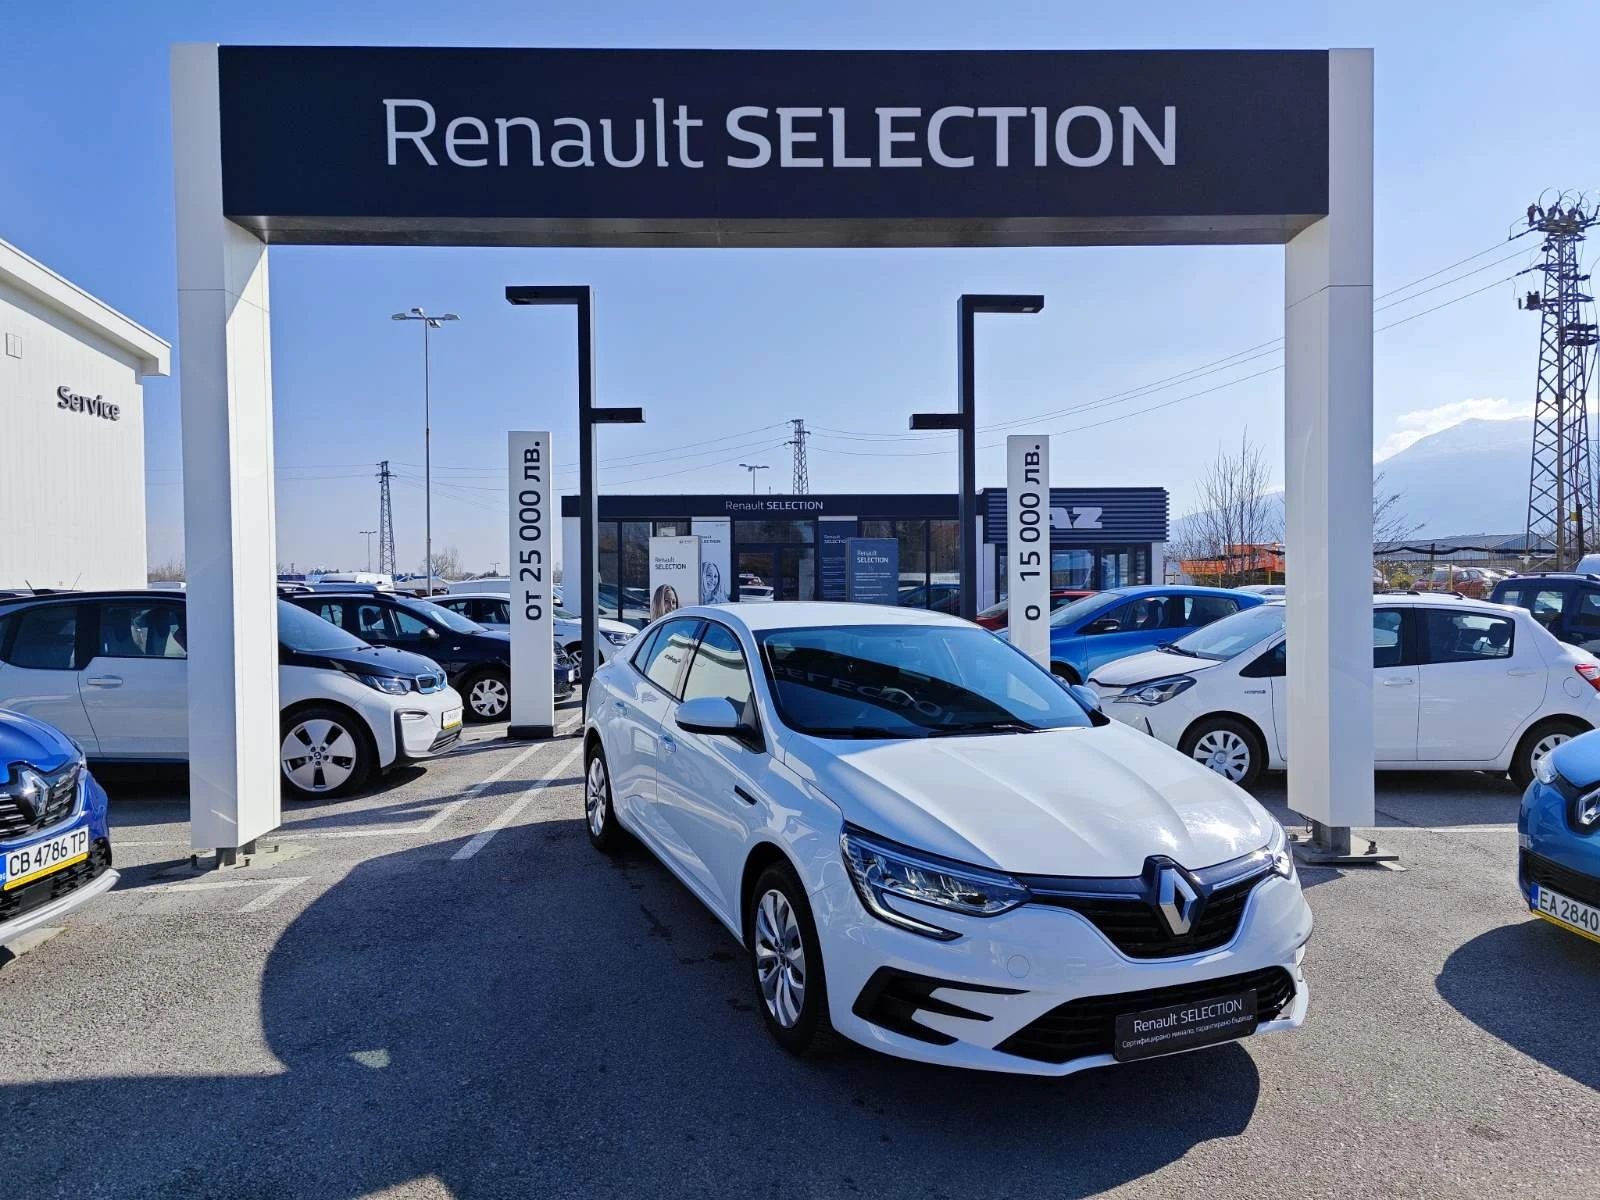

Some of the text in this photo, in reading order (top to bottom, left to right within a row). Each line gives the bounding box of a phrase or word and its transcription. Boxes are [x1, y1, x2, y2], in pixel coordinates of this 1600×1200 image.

[383, 97, 1177, 169] Renault SELECTION
[57, 385, 120, 421] Service
[1024, 444, 1041, 485] лв.
[725, 500, 824, 510] Renault SELECTION
[1019, 491, 1041, 543] 000
[518, 441, 542, 621] от 25 000 лв.
[1020, 550, 1041, 582] 15
[9, 832, 86, 876] CB 4786 TP
[1540, 891, 1599, 932] EA 2840
[1134, 998, 1243, 1032] Renault SELECTION
